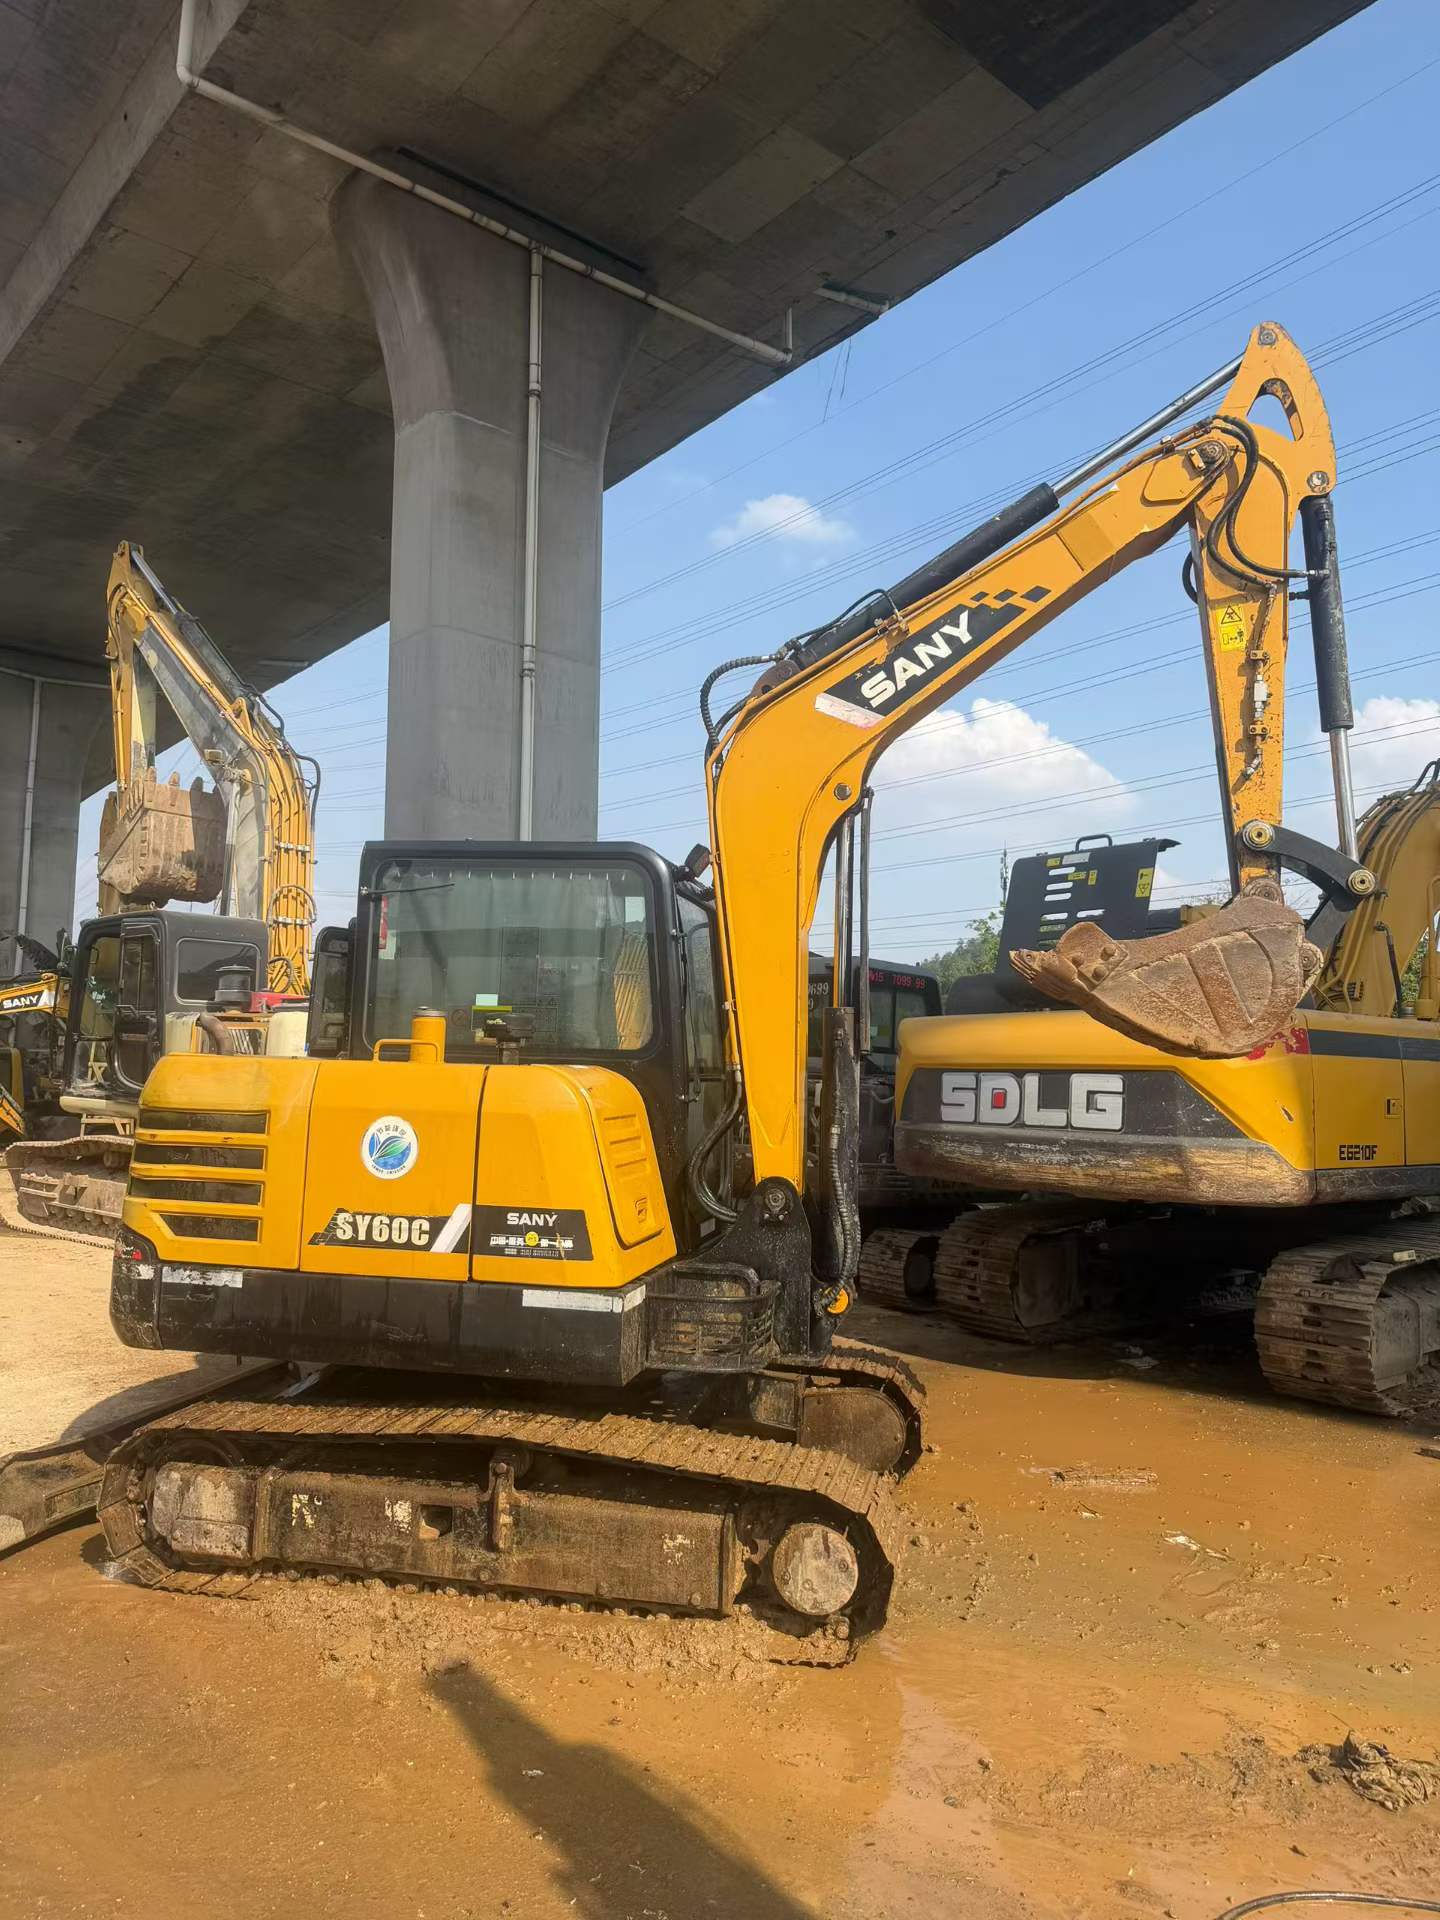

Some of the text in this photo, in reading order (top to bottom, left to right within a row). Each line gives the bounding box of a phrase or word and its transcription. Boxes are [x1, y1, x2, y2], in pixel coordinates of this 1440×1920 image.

[860, 609, 973, 708] SANY
[2, 995, 39, 1009] SANY
[940, 1071, 1125, 1132] SDLG
[335, 1212, 431, 1246] SY60C
[506, 1212, 559, 1227] SANY
